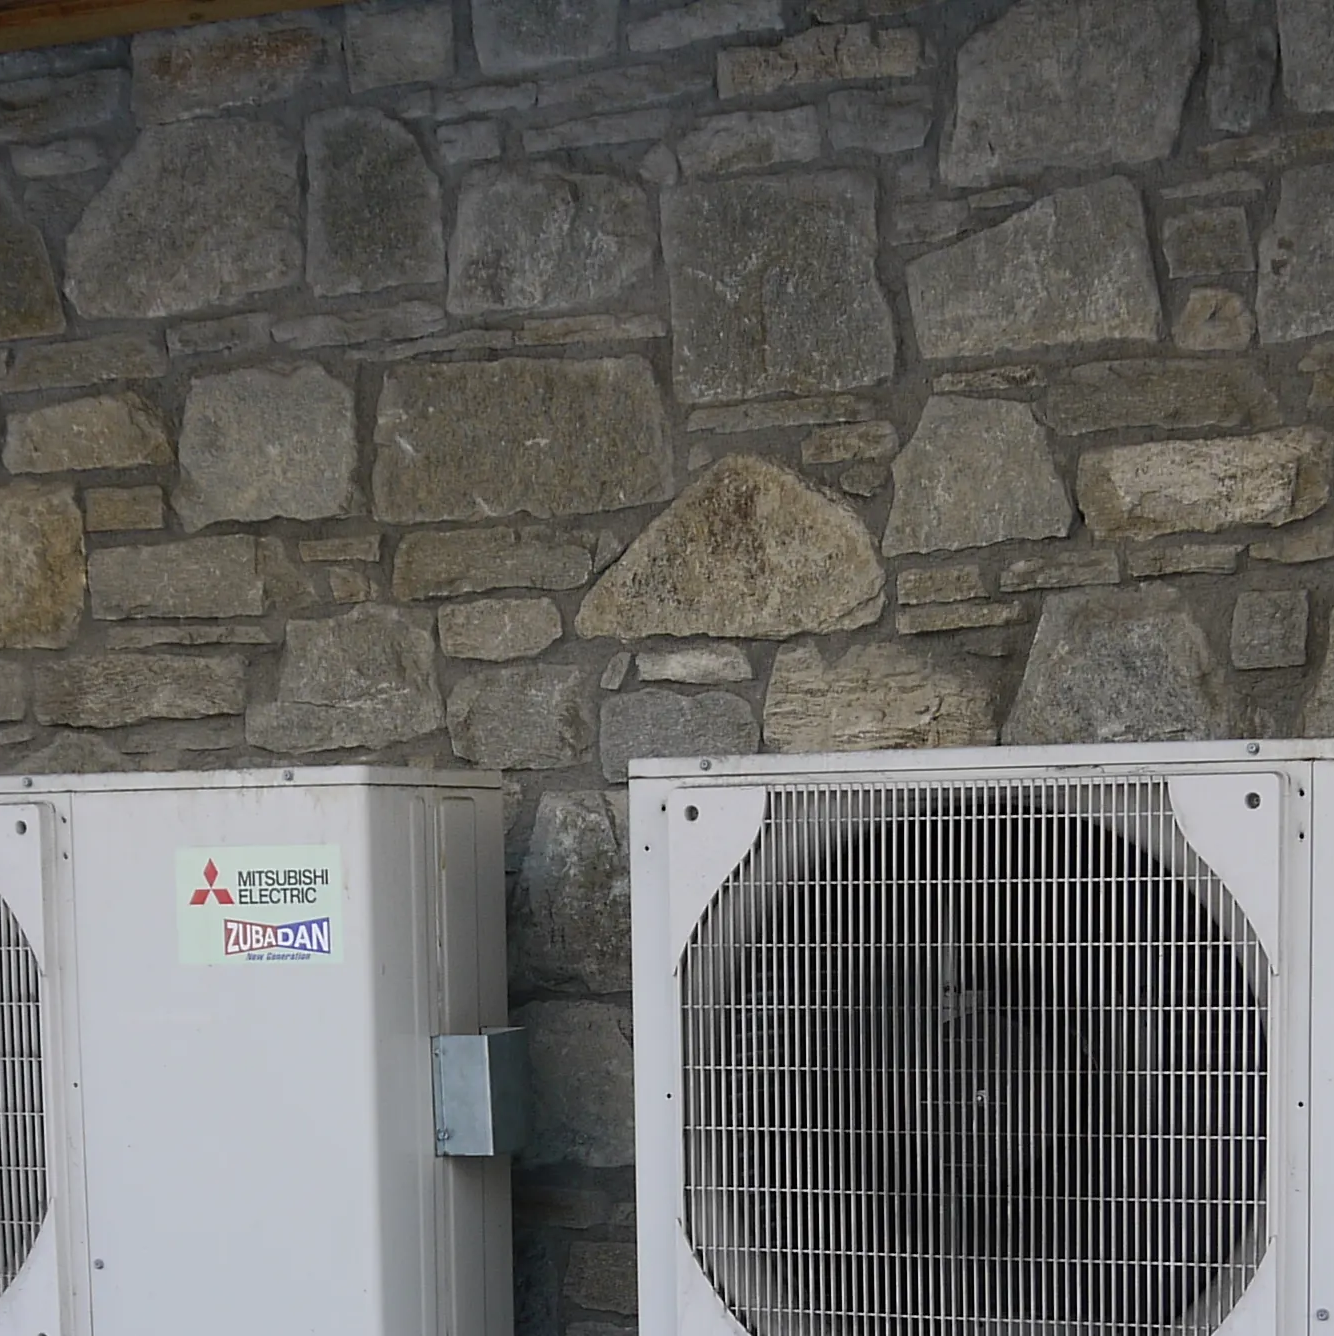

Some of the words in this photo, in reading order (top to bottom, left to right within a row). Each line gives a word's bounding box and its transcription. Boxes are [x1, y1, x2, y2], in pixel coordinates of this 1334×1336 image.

[237, 869, 329, 887] MITSUBISHI
[239, 887, 317, 904] ELECTRIC
[226, 920, 329, 953] ZUBADAN
[245, 953, 264, 961] New
[267, 953, 311, 961] Generation
